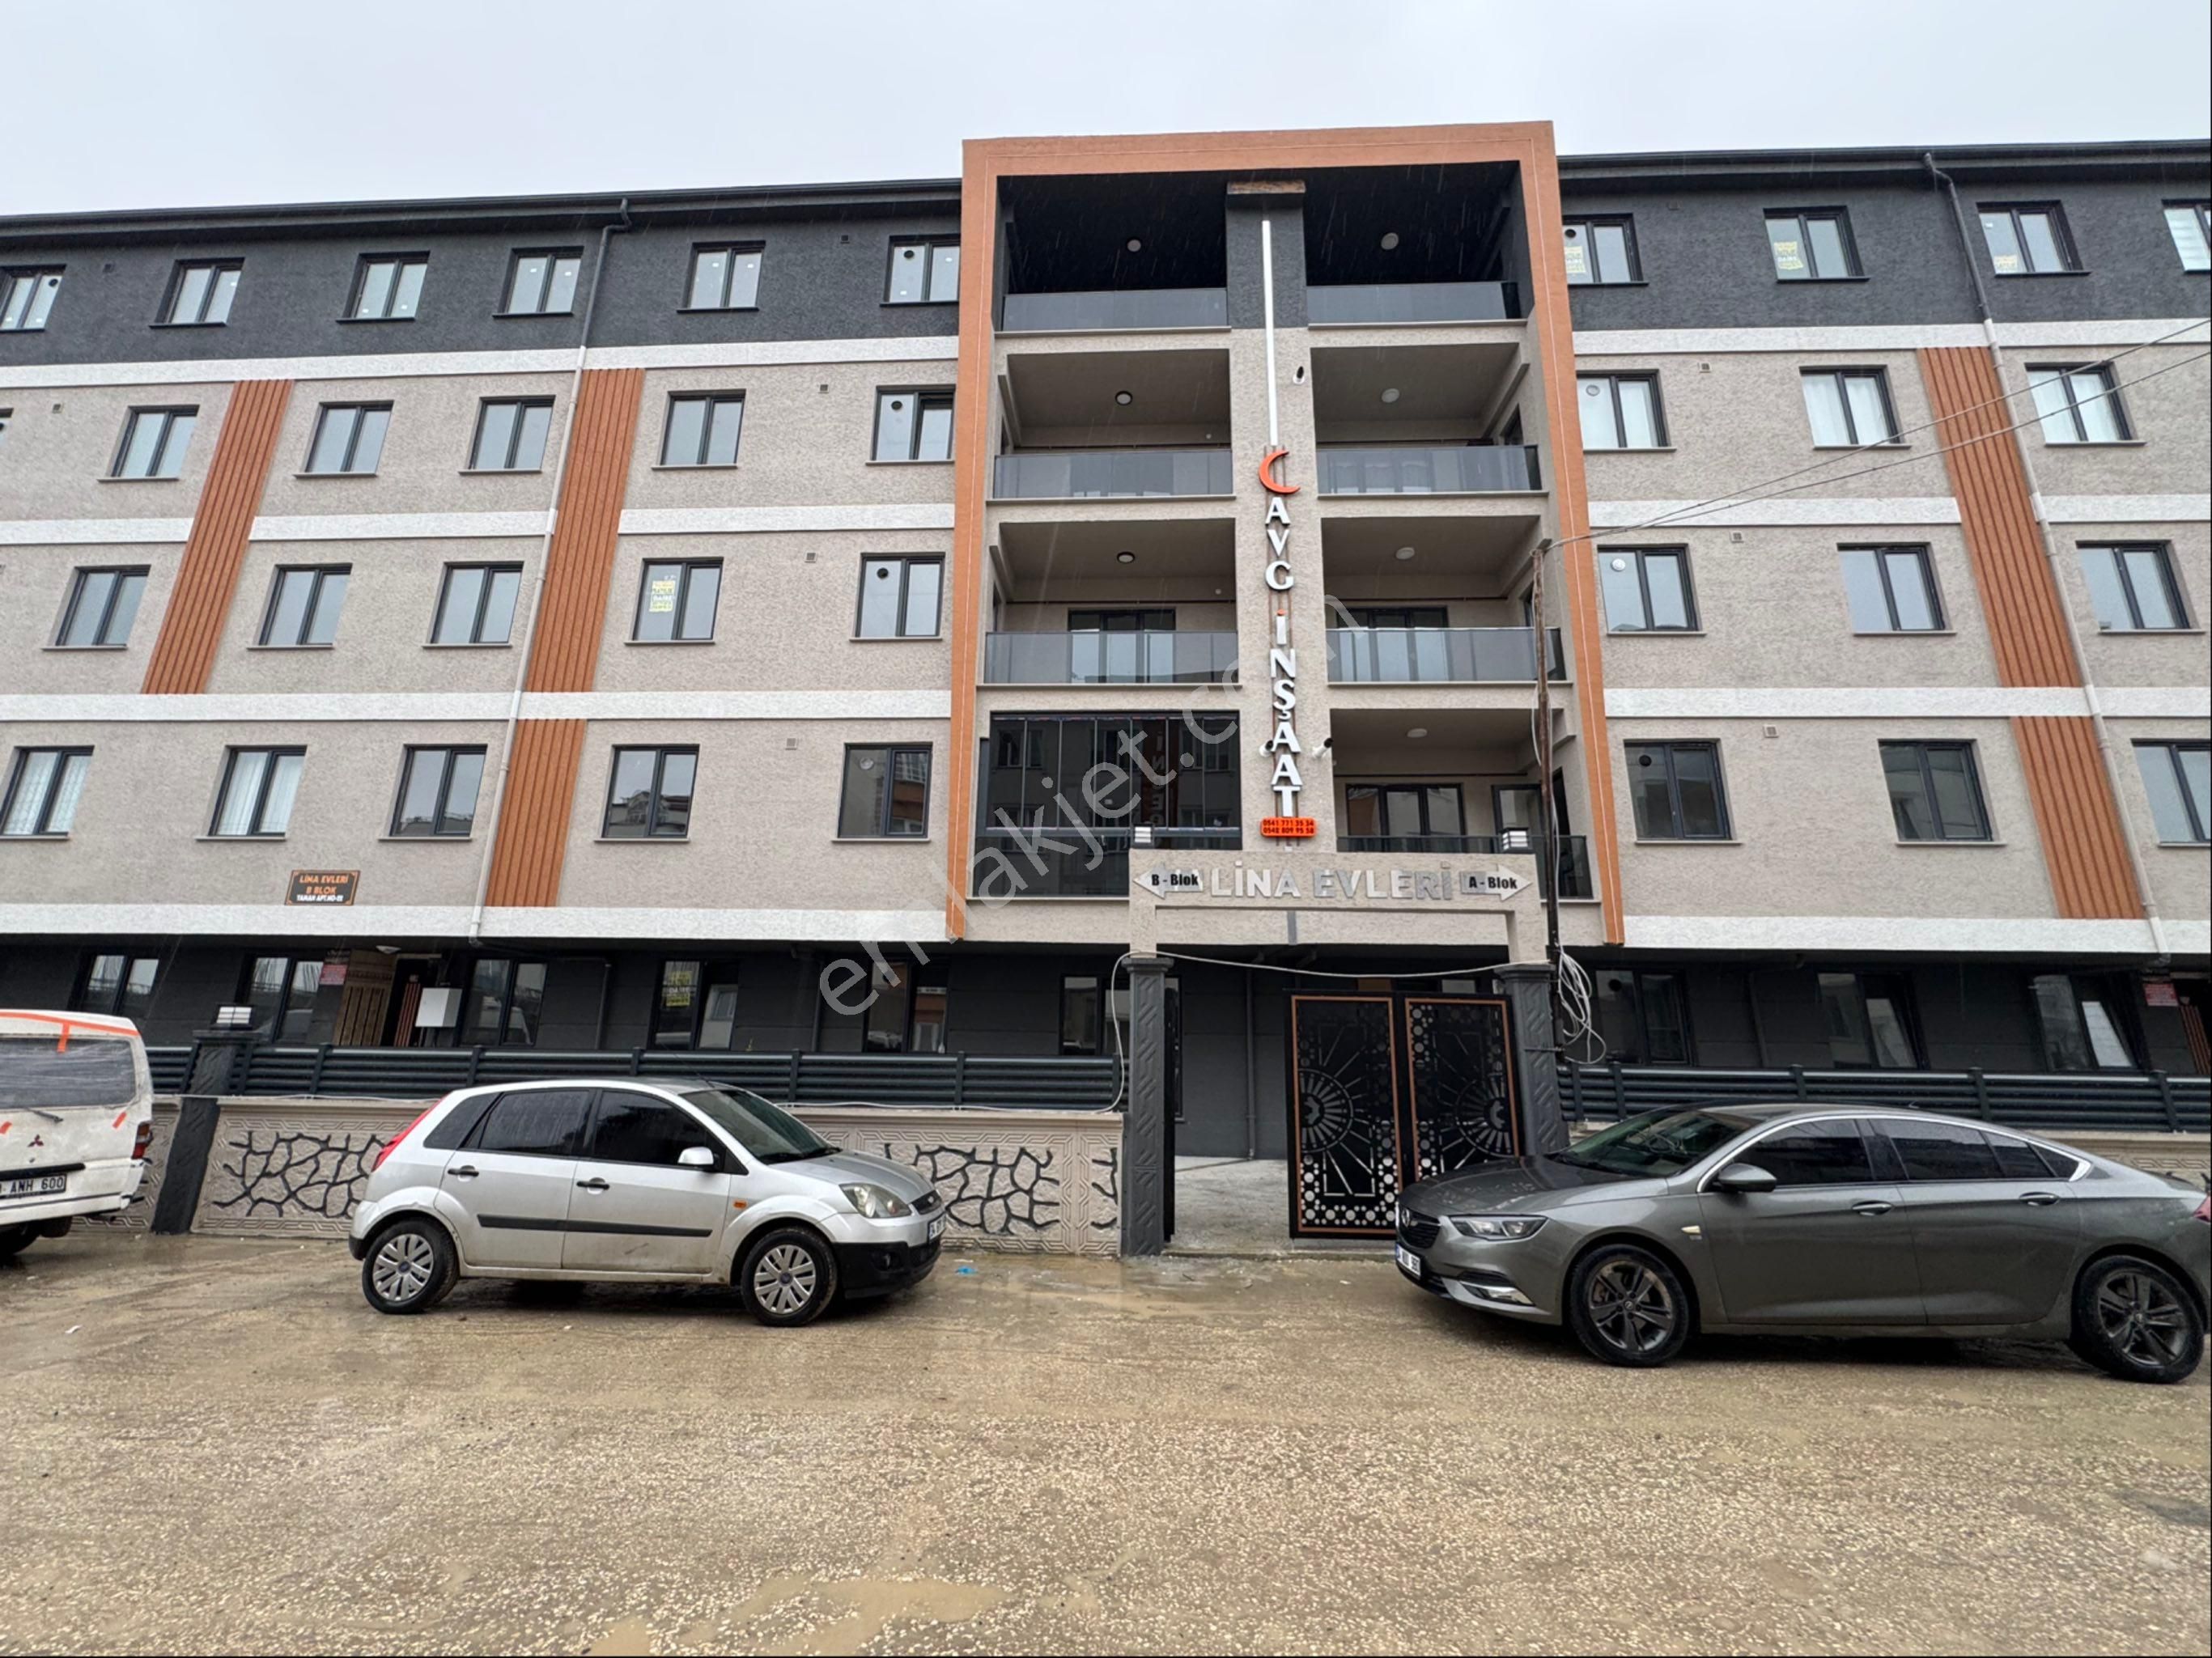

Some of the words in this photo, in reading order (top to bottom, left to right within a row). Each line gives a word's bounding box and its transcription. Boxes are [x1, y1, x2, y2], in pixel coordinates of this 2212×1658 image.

[1151, 873, 1160, 886] B
[1170, 873, 1199, 887] Blok
[1211, 860, 1301, 898] LİNA
[1313, 861, 1454, 900] EVLERİ
[1468, 876, 1478, 888] A
[1487, 876, 1518, 889] Blok
[313, 885, 338, 895] BLOK
[10, 1179, 34, 1194] ANH
[40, 1177, 65, 1190] 600
